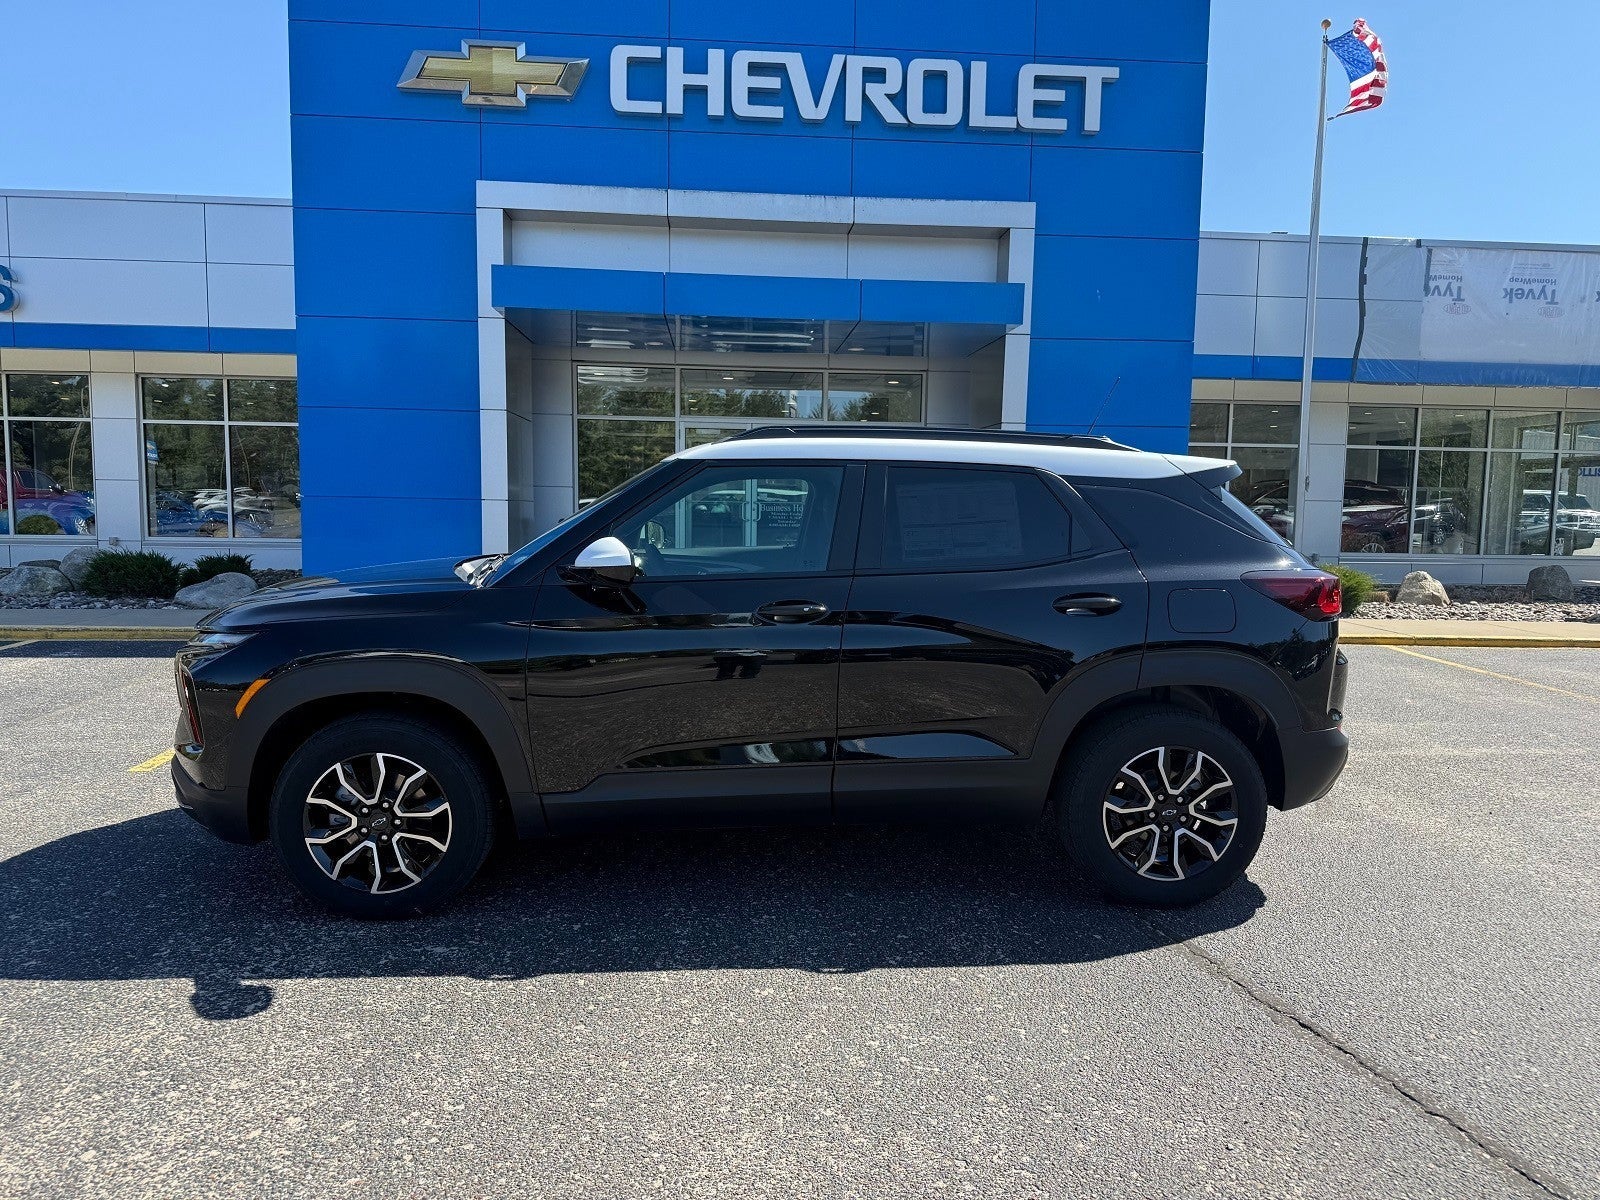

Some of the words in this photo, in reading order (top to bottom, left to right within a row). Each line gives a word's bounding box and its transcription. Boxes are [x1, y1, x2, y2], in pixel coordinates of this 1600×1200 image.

[609, 45, 1119, 134] CHEVROLET
[1509, 276, 1557, 286] HomeWrap
[1502, 285, 1559, 305] Tyvek
